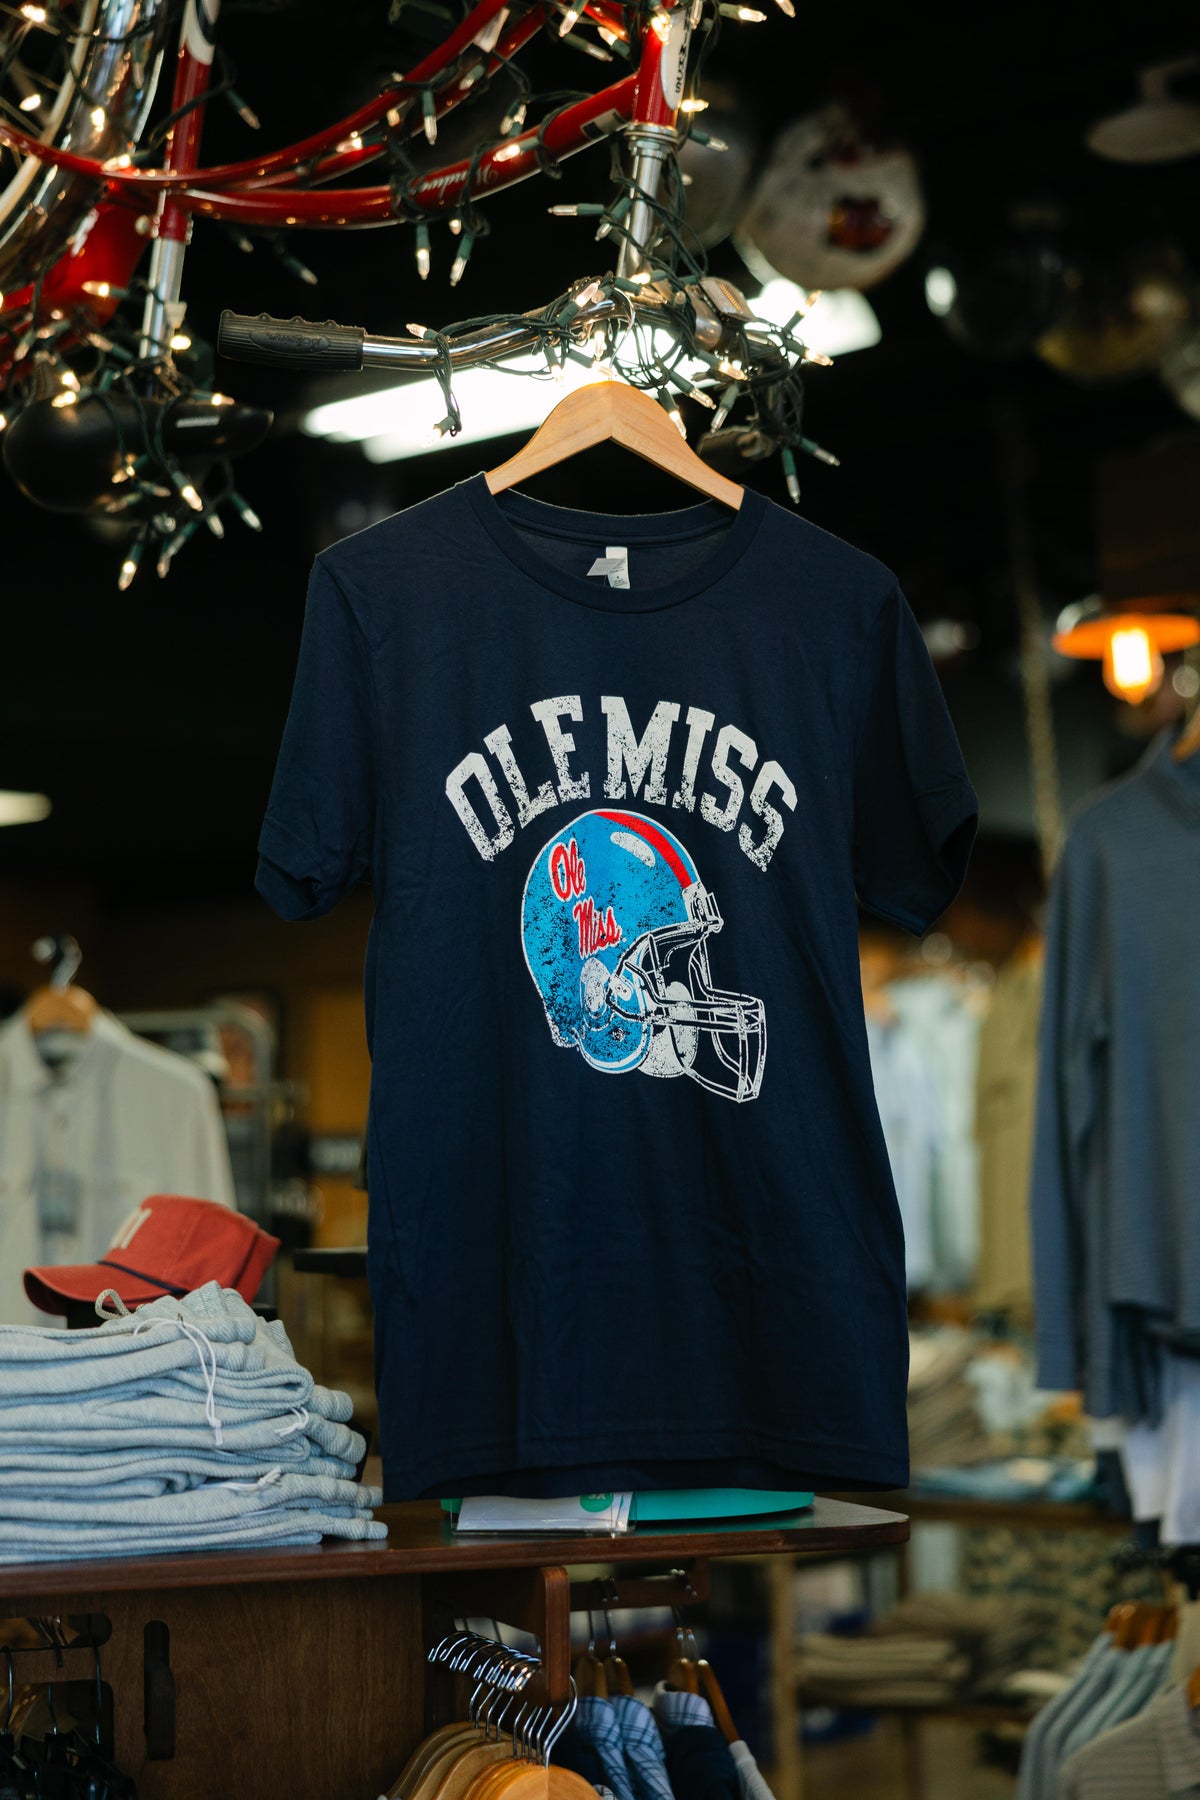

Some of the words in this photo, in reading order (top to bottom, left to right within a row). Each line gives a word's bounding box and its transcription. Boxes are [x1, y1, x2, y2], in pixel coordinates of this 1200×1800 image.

[446, 695, 590, 862] OLE
[601, 696, 798, 871] MISS
[548, 838, 586, 902] Ole
[573, 896, 622, 959] Miss
